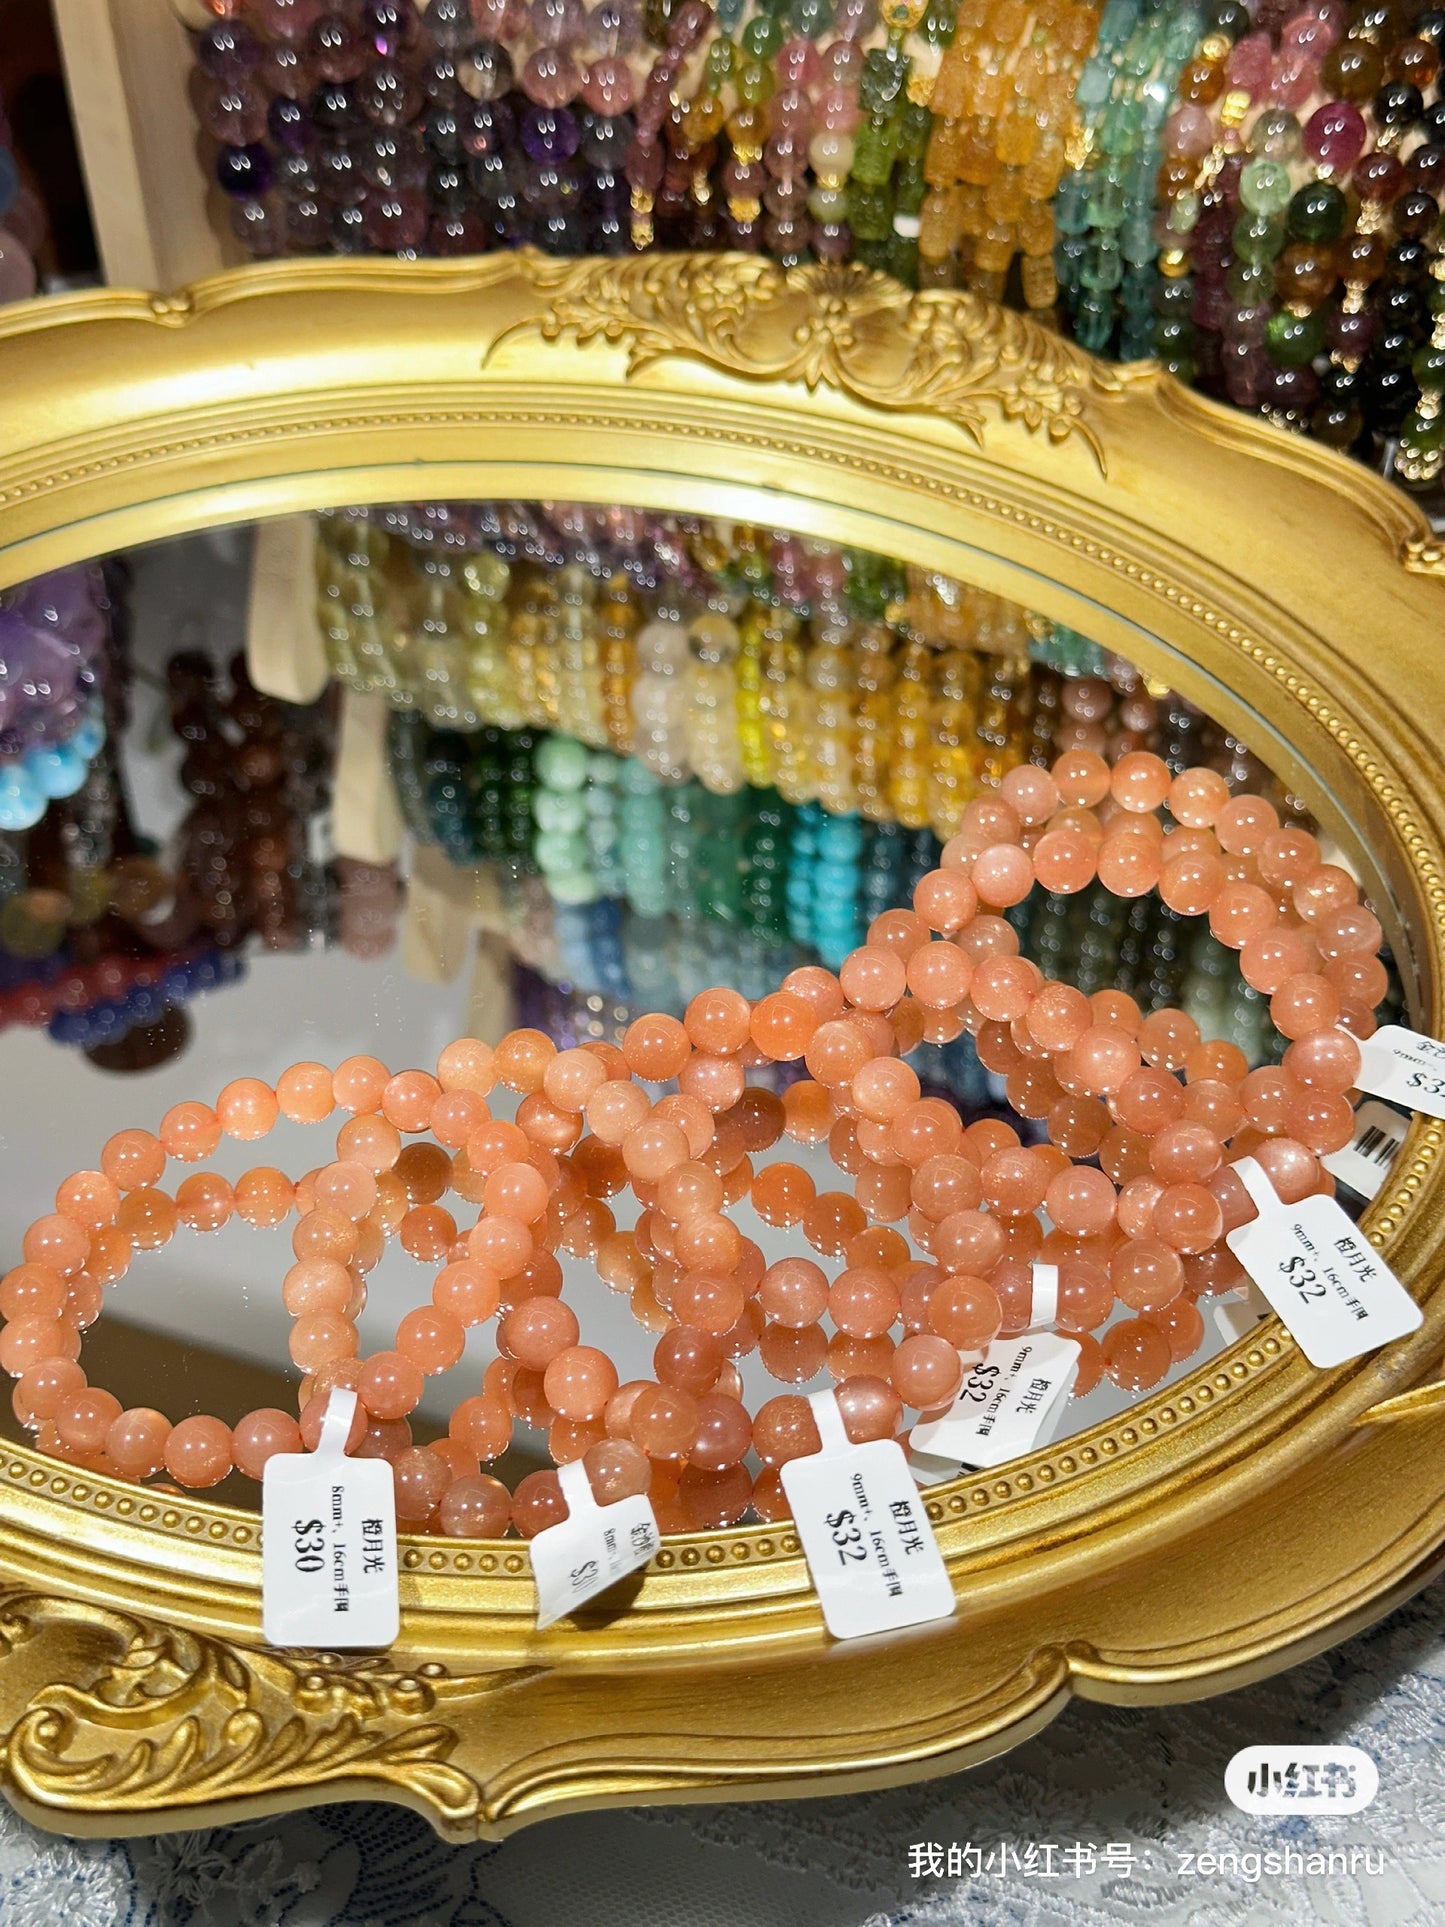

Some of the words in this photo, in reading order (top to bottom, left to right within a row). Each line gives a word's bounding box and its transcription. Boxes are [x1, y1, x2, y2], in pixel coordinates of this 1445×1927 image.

[1277, 1256, 1327, 1304] $32
[1334, 1237, 1378, 1282] 橙月光
[960, 1363, 1002, 1402] $32
[1016, 1378, 1052, 1414] 橙月光
[290, 1519, 327, 1573] $30
[361, 1519, 385, 1573] 橙月光
[824, 1510, 867, 1566] $32
[889, 1501, 924, 1555] 橙月光
